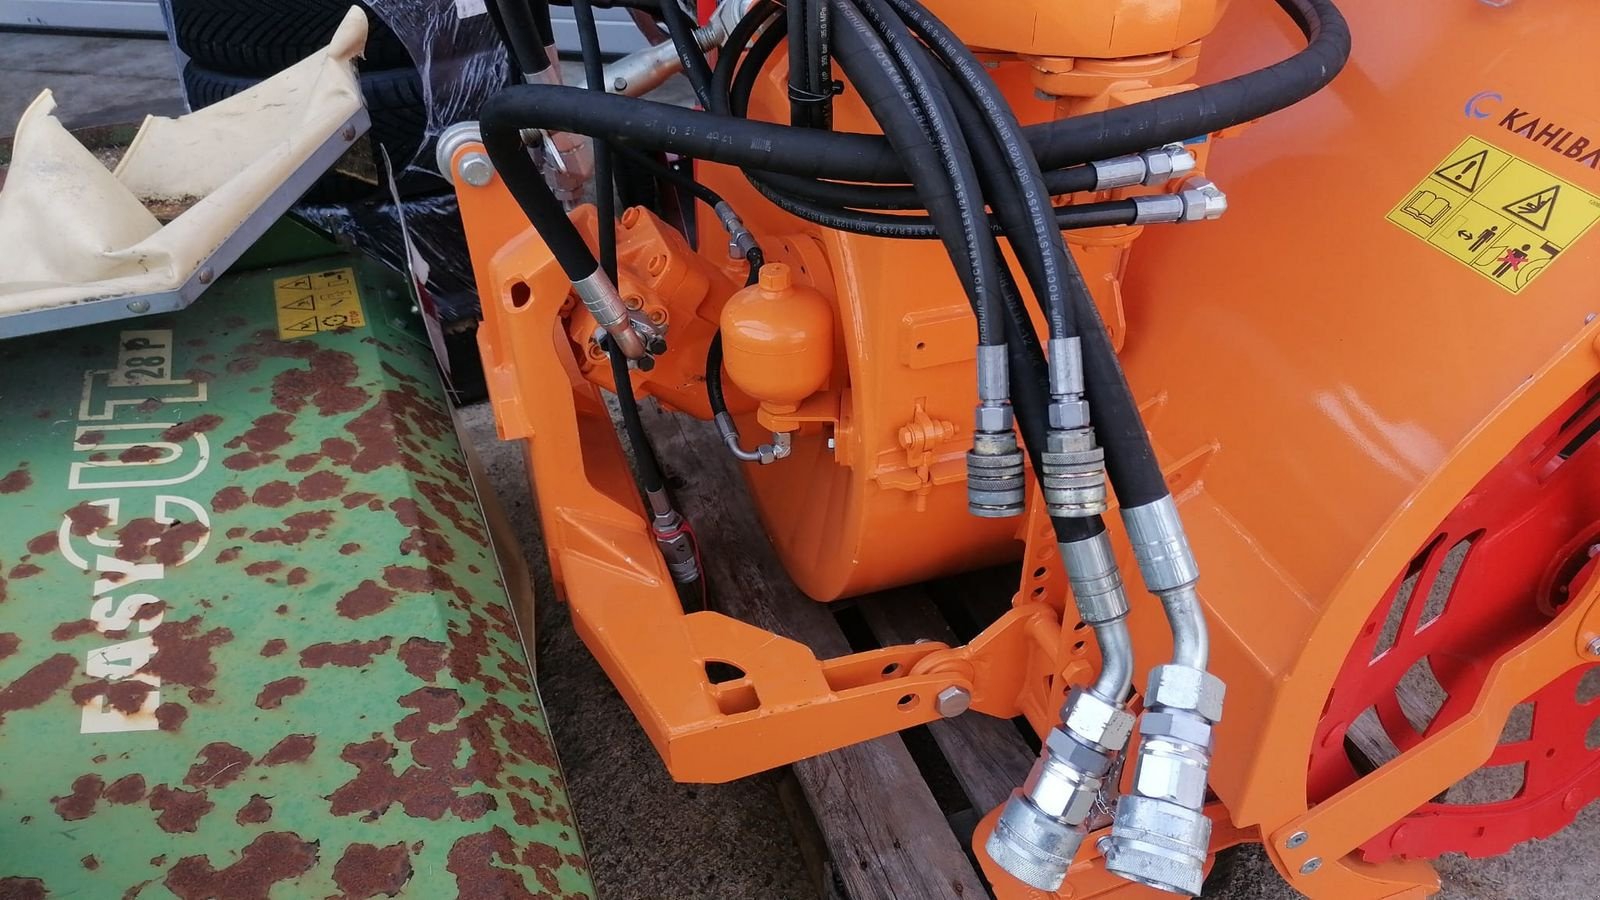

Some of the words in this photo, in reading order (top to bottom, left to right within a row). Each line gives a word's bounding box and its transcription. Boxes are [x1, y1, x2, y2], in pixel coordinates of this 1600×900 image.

[971, 78, 986, 97] SAE
[982, 94, 997, 114] 2SC
[991, 111, 1005, 129] 857
[998, 125, 1011, 141] EN
[1498, 107, 1600, 171] KAHLBA
[1006, 140, 1024, 168] 11237
[1018, 167, 1030, 185] ISO
[874, 222, 938, 236] ASTER/2SC
[952, 181, 983, 293] ROCKMASTER/2SC
[1024, 188, 1061, 302] ROCKMASTER/2SC
[122, 336, 166, 350] P
[124, 355, 167, 380] 28
